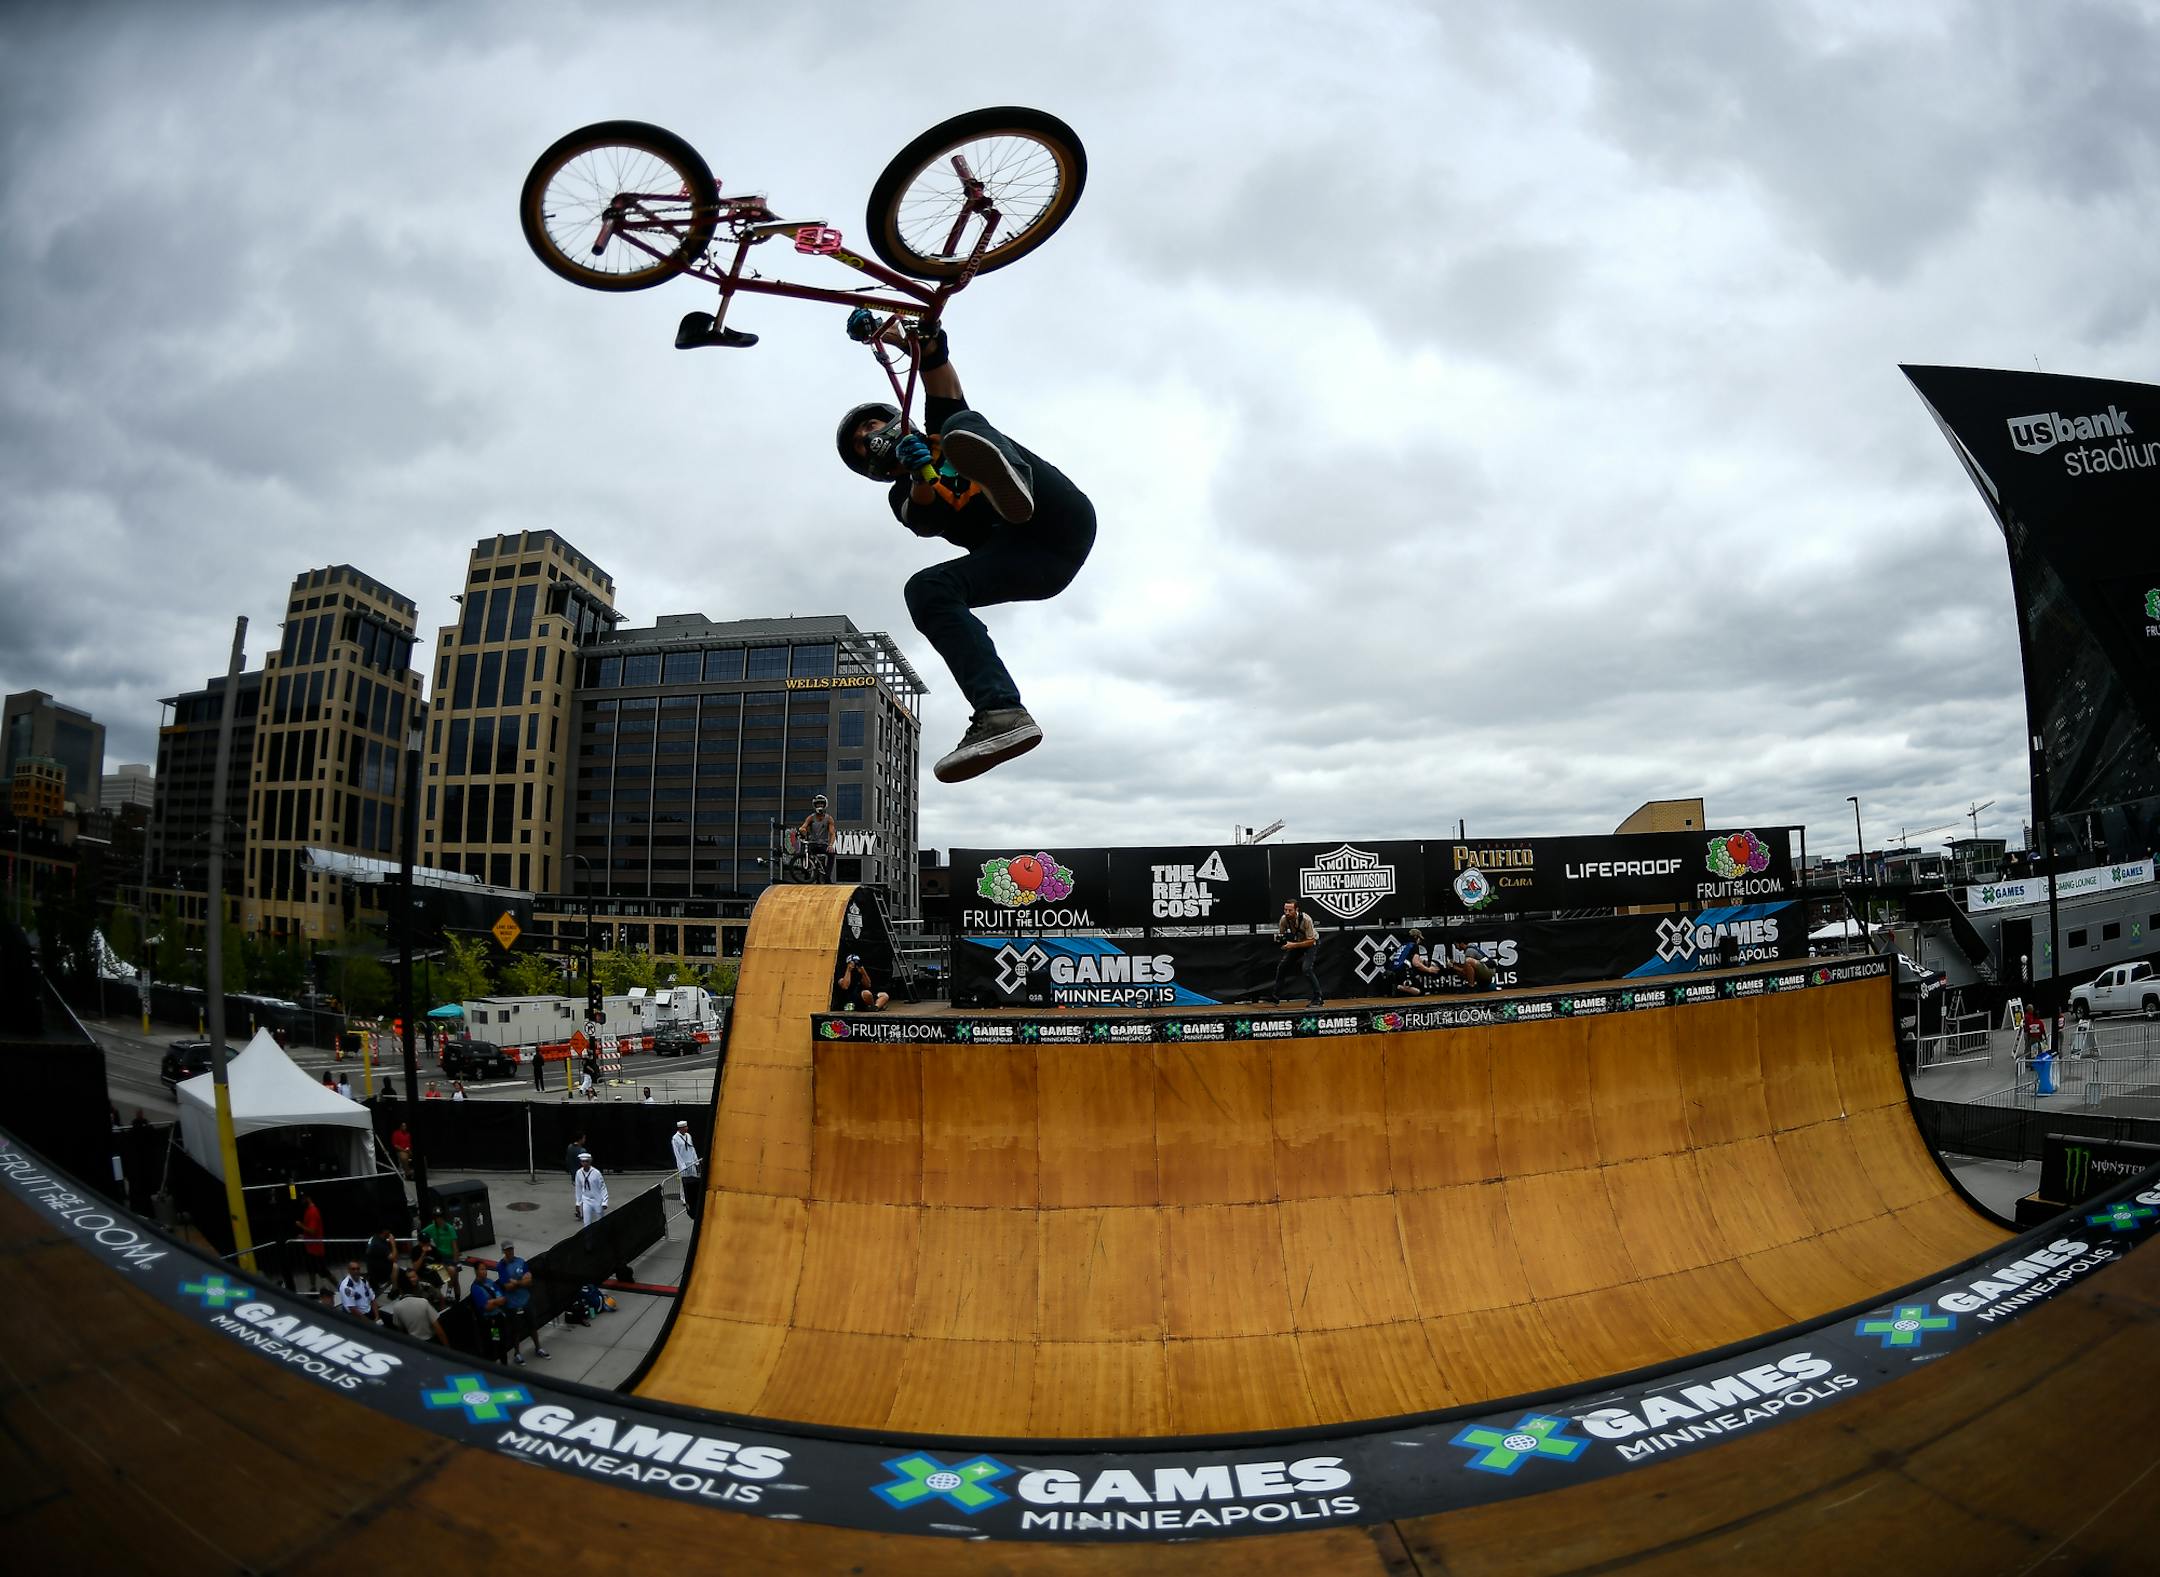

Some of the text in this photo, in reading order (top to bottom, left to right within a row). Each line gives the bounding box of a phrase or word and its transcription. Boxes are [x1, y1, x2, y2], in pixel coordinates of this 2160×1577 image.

[785, 676, 876, 689] WELLS FARGO
[833, 832, 877, 855] NAVY
[1326, 859, 1374, 871] MOTOR
[1453, 846, 1534, 870] PACIFICO
[1151, 865, 1195, 882] THE
[1565, 859, 1683, 879] LIFEPROOF
[2121, 866, 2143, 879] GAMES
[1308, 872, 1388, 890] HARLEY-DAVIDSON
[1697, 880, 1735, 899] FRUIT
[1745, 878, 1782, 895] LOOM
[1152, 882, 1212, 899] REAL
[1996, 885, 2025, 899] GAMES
[1152, 899, 1212, 917] COST
[1327, 892, 1369, 911] CYCLES
[963, 909, 1016, 928] FRUIT
[1035, 909, 1089, 927] LOOM
[1050, 955, 1175, 983] GAMES
[1736, 979, 1764, 991] GAMES
[1779, 974, 1805, 986] GAMES
[1634, 991, 1665, 1002] GAMES
[1686, 985, 1715, 996] GAMES
[1517, 1003, 1553, 1015] GAMES
[1573, 997, 1607, 1010] GAMES
[852, 1023, 888, 1038] FRUIT
[973, 1026, 1013, 1036] GAMES
[1039, 1025, 1080, 1036] GAMES
[1110, 1025, 1152, 1035] GAMES
[1183, 1023, 1224, 1034] GAMES
[1252, 1020, 1293, 1032] GAMES
[1318, 1017, 1358, 1029] GAMES
[0, 1153, 168, 1266] FRUIT OF THE LOOM
[1936, 1238, 2089, 1313] GAMES
[1982, 1246, 2114, 1322] MINNEAPOLIS
[233, 1303, 402, 1377] GAMES
[210, 1314, 364, 1389] MINNEAPOLIS
[1582, 1351, 1834, 1440] GAMES
[1616, 1374, 1858, 1462] MINNEAPOLIS
[518, 1404, 792, 1480] GAMES
[497, 1431, 764, 1503] MINNEAPOLIS
[1017, 1456, 1352, 1504] GAMES
[1021, 1496, 1361, 1530] MINNEAPOLIS
